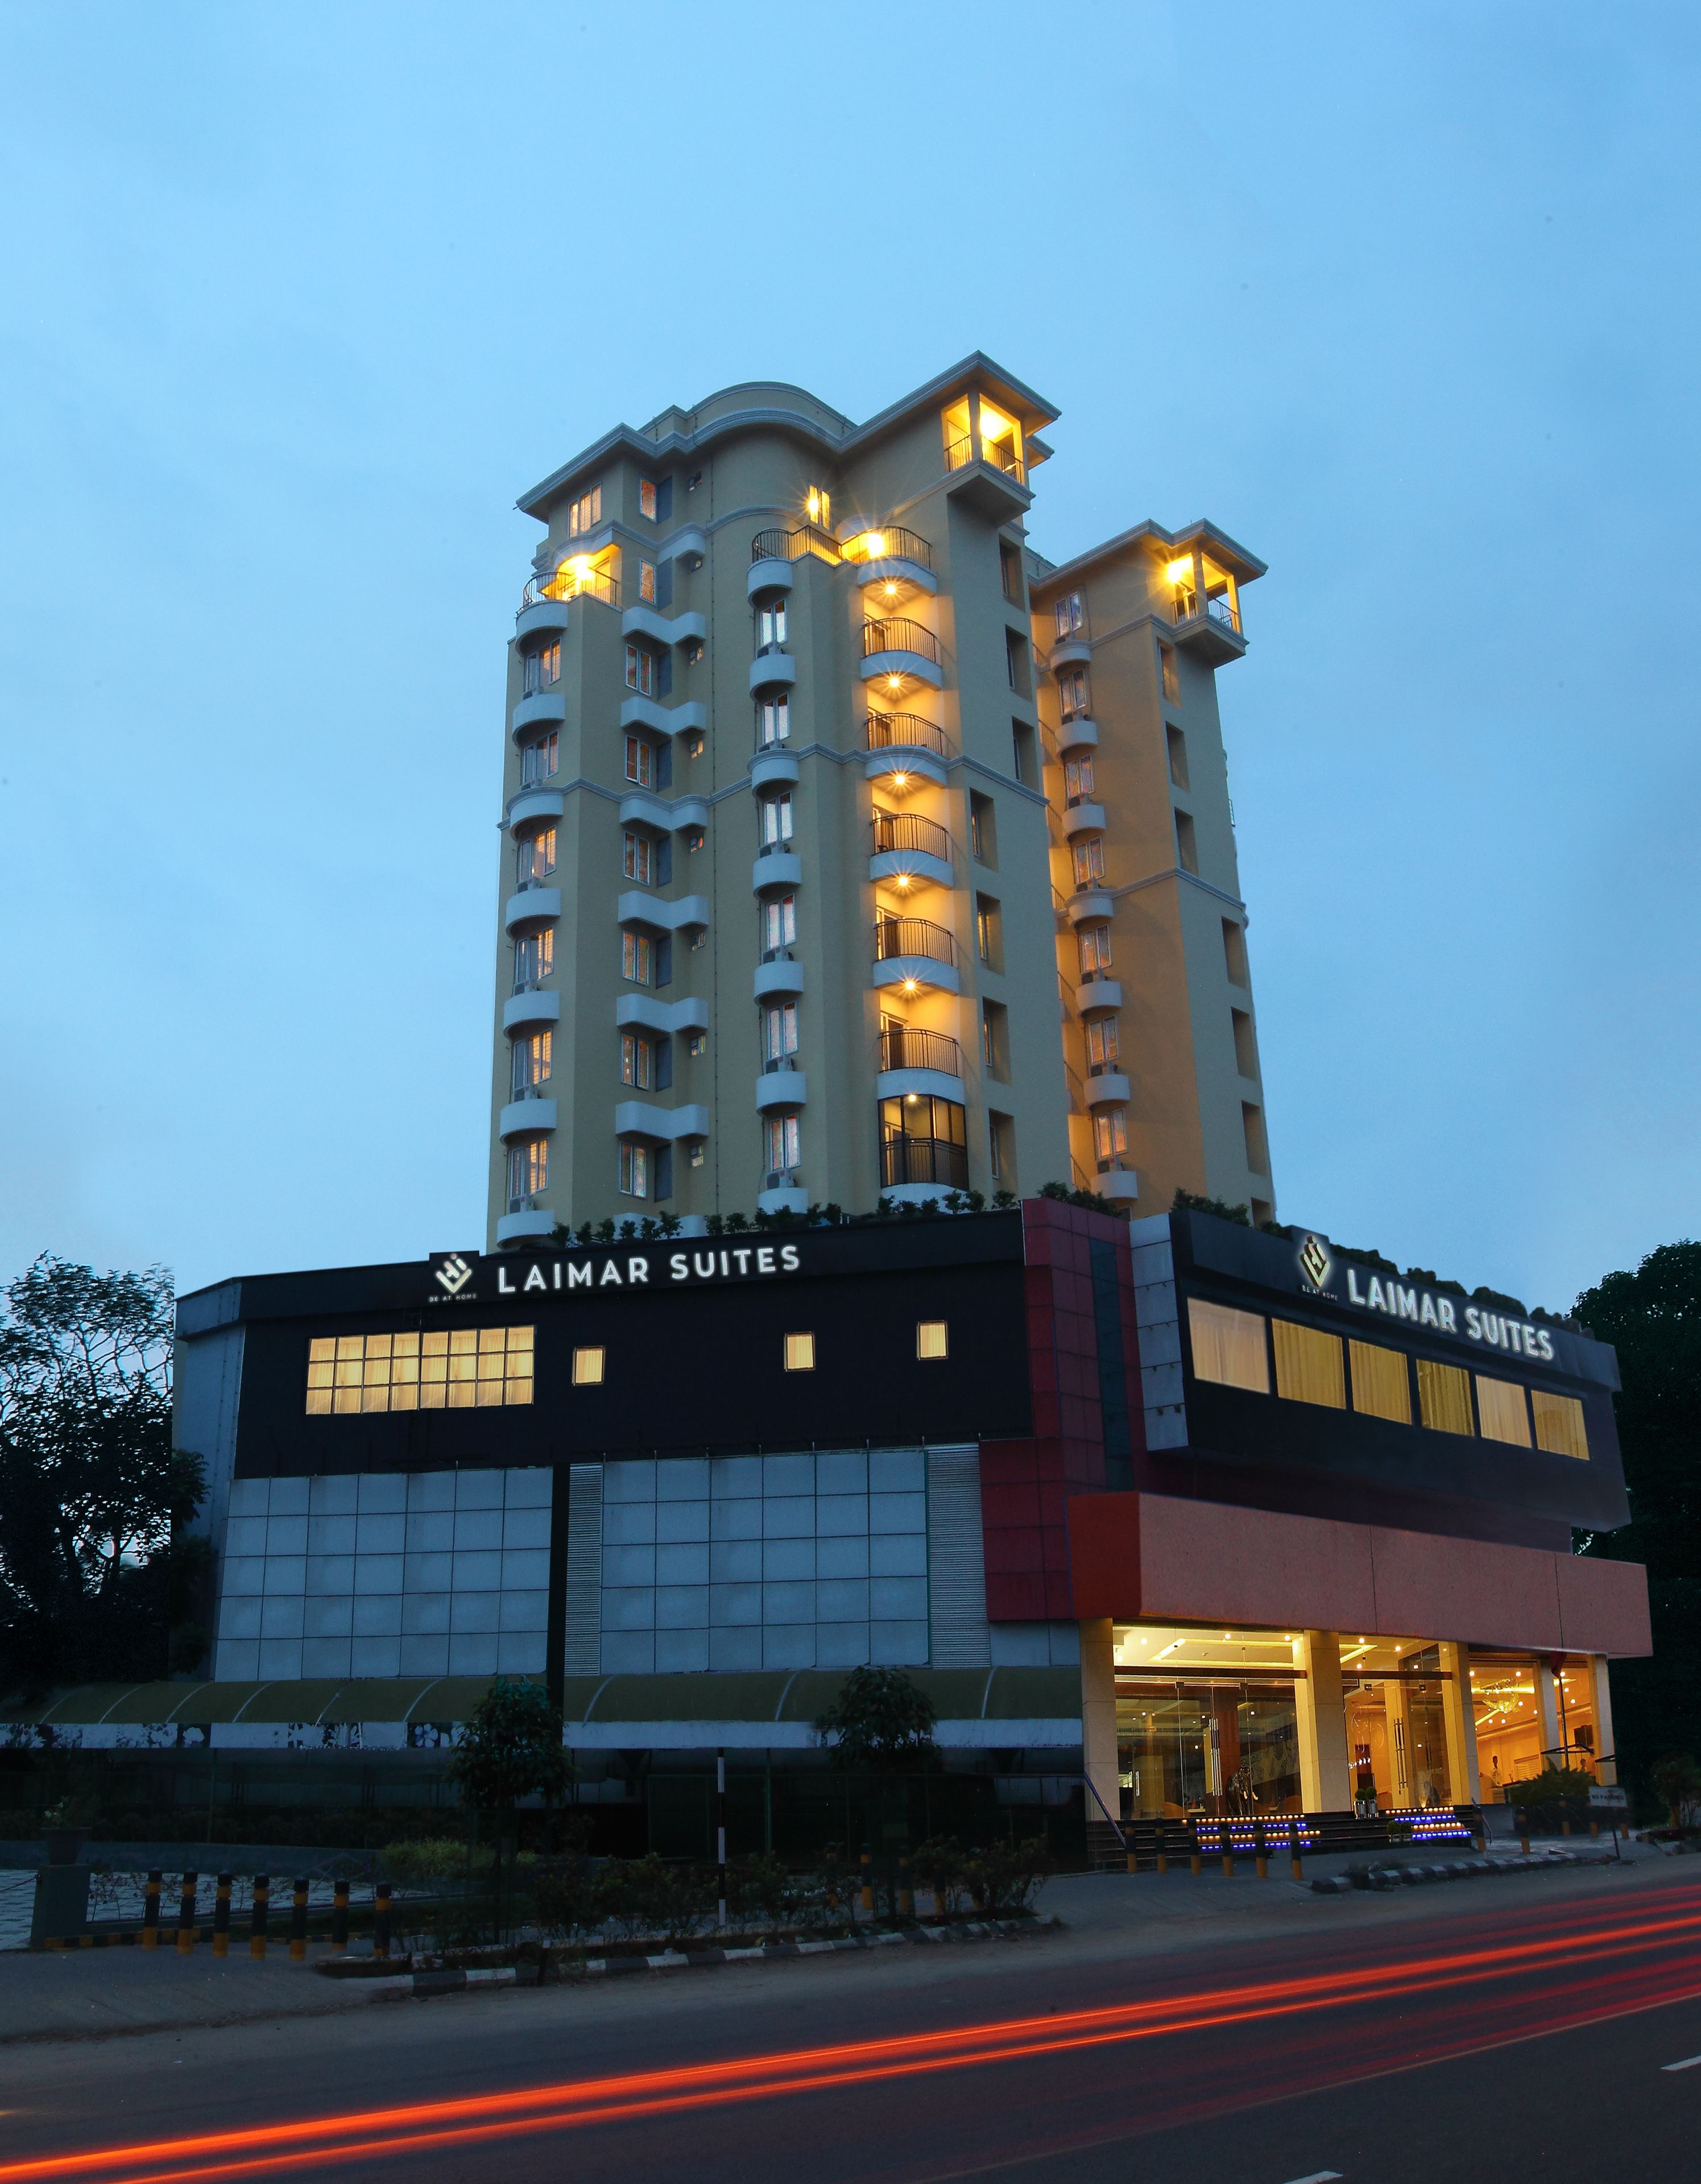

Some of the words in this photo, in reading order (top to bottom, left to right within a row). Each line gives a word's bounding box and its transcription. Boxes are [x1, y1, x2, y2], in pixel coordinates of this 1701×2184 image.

[499, 1258, 648, 1293] LAIMAR
[671, 1246, 799, 1279] SUITES
[1323, 1292, 1338, 1301] HOME
[1347, 1269, 1457, 1333] LAIMAR
[1466, 1308, 1554, 1360] SUITES
